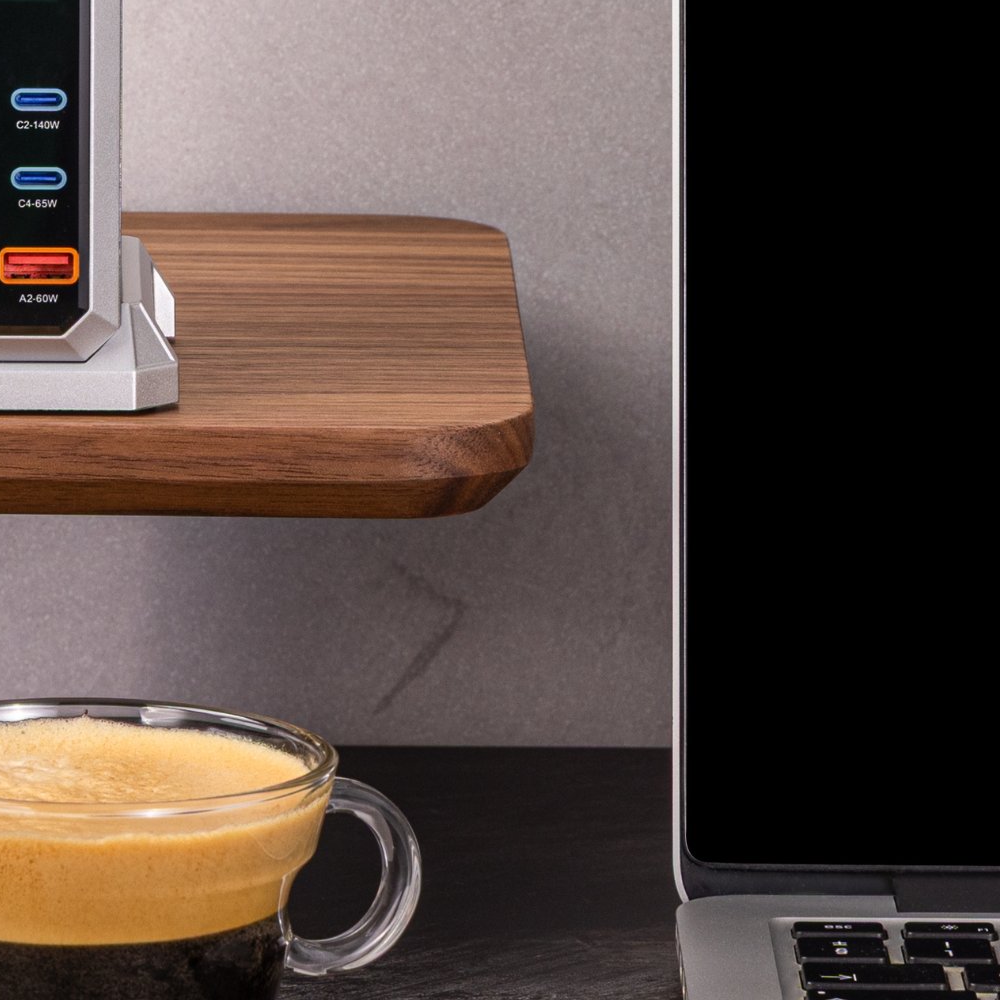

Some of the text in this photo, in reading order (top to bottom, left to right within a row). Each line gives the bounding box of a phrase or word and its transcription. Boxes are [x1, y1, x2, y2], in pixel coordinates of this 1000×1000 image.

[15, 120, 60, 130] C2-140W
[17, 198, 58, 209] C4-65W
[18, 293, 59, 303] A2-60W
